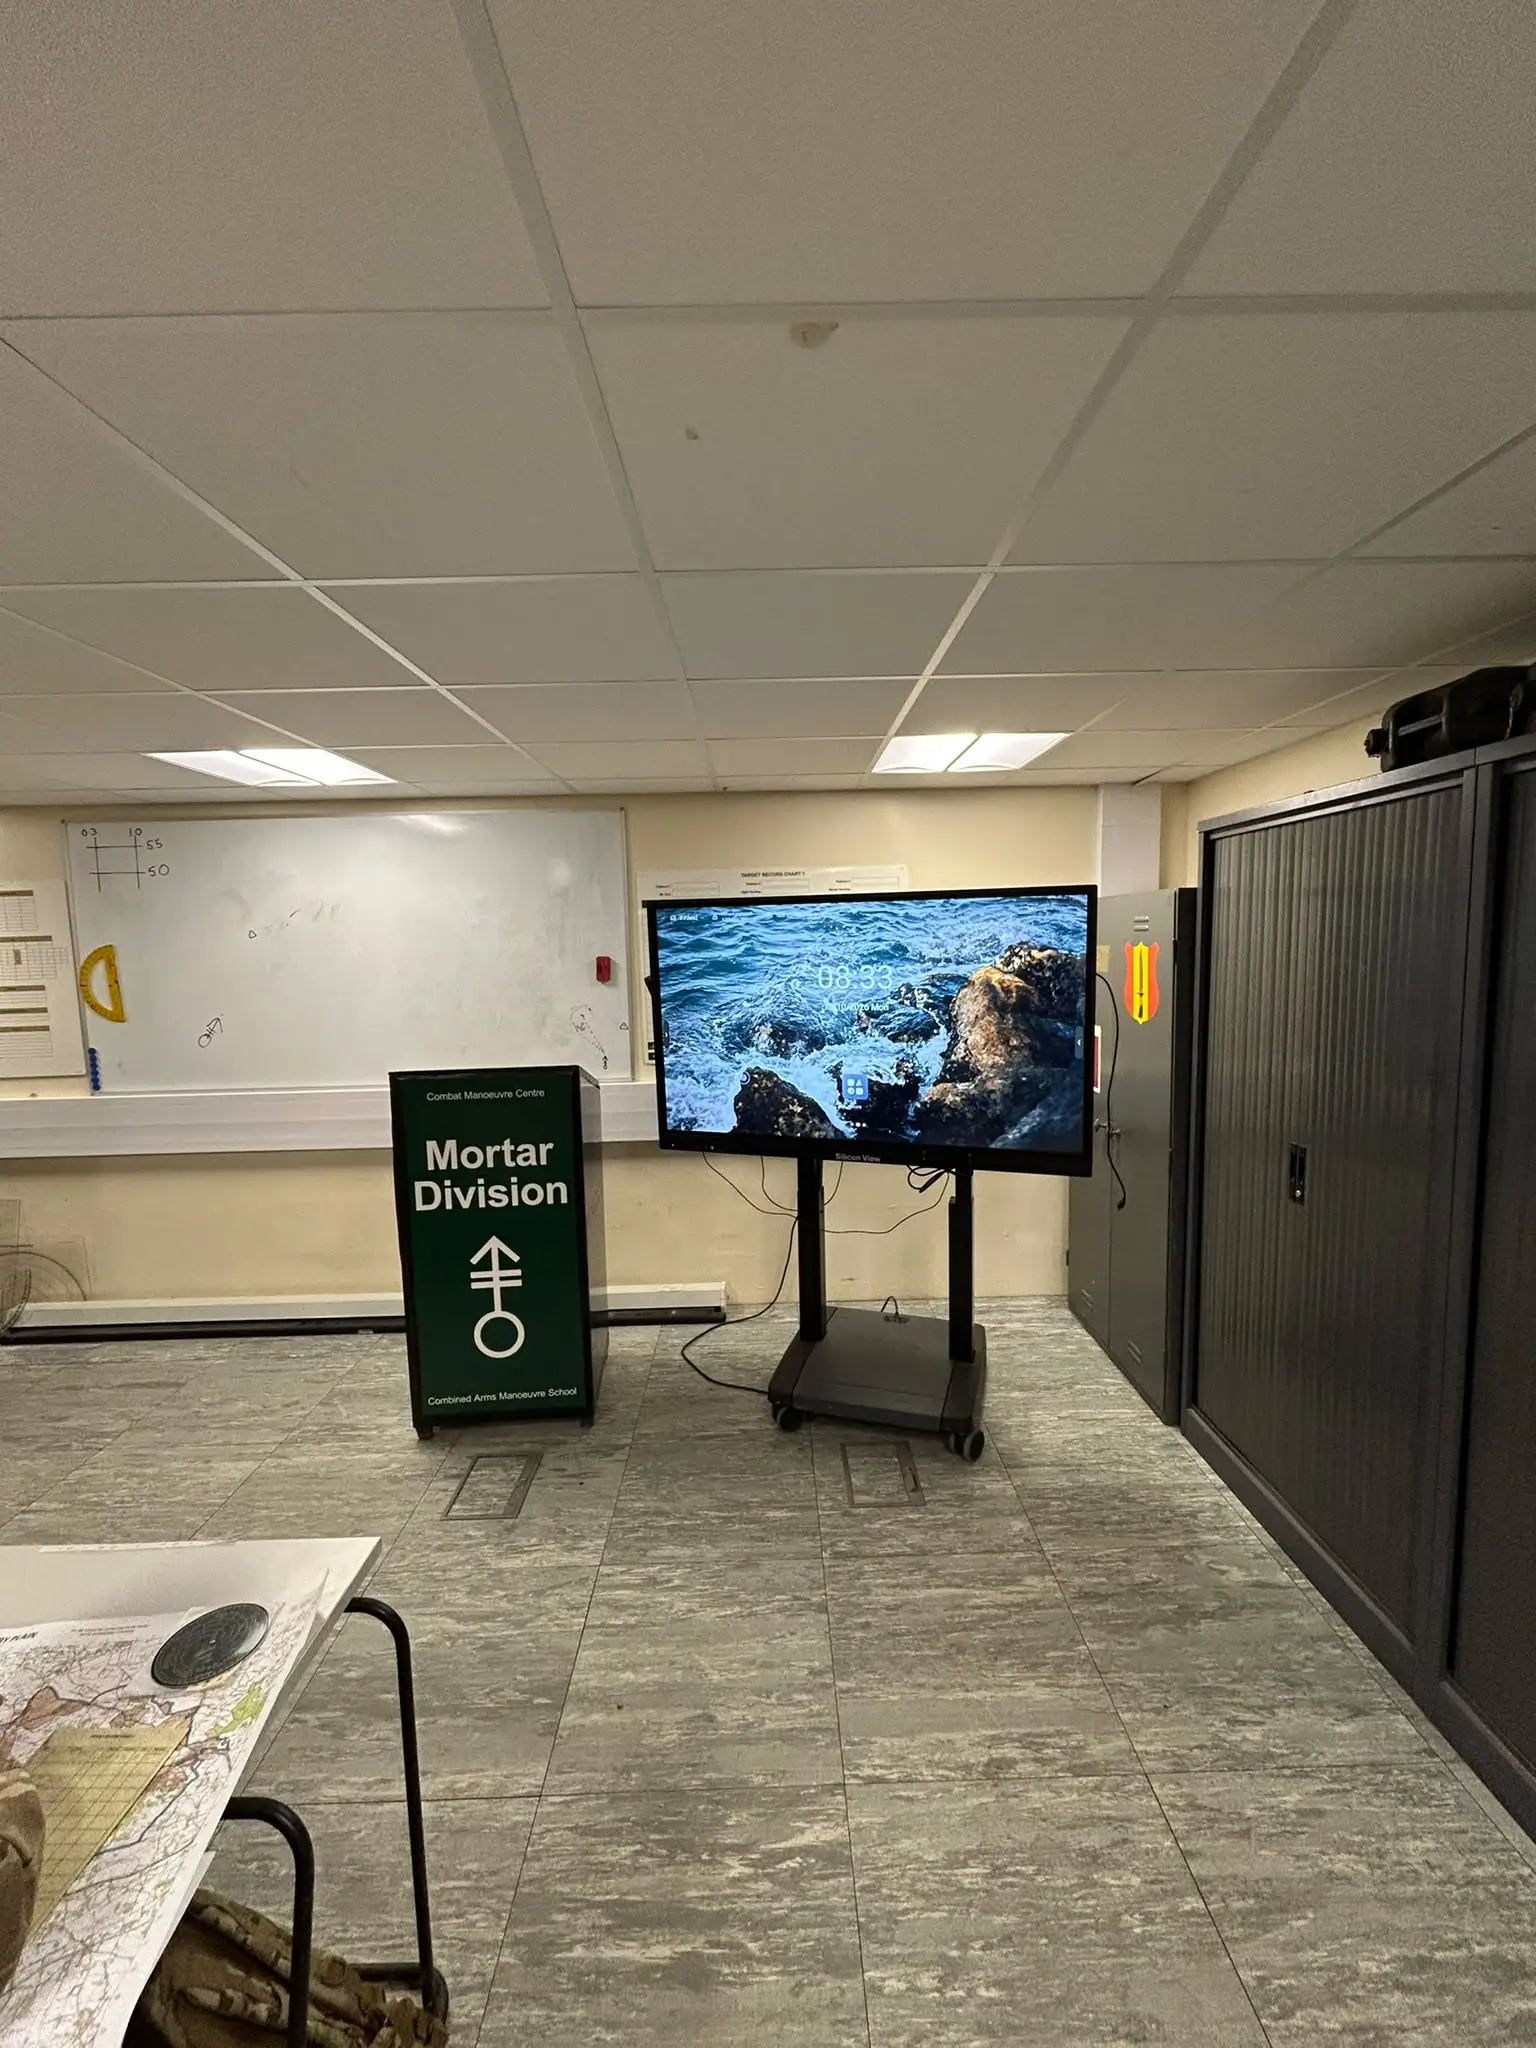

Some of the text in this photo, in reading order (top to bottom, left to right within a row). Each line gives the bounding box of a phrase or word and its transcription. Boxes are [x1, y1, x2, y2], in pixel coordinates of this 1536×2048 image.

[81, 828, 97, 837] 03
[129, 828, 143, 838] 10
[146, 839, 163, 850] 55
[148, 864, 170, 877] 50
[818, 965, 893, 989] 08:33
[871, 1002, 889, 1011] Mon
[426, 1088, 546, 1101] Combat Manoeuvre Centre
[425, 1138, 555, 1171] Mortar
[835, 1152, 881, 1163] Silicon View
[414, 1176, 568, 1211] Division
[427, 1387, 578, 1406] Combined Arms Manoeuvre School
